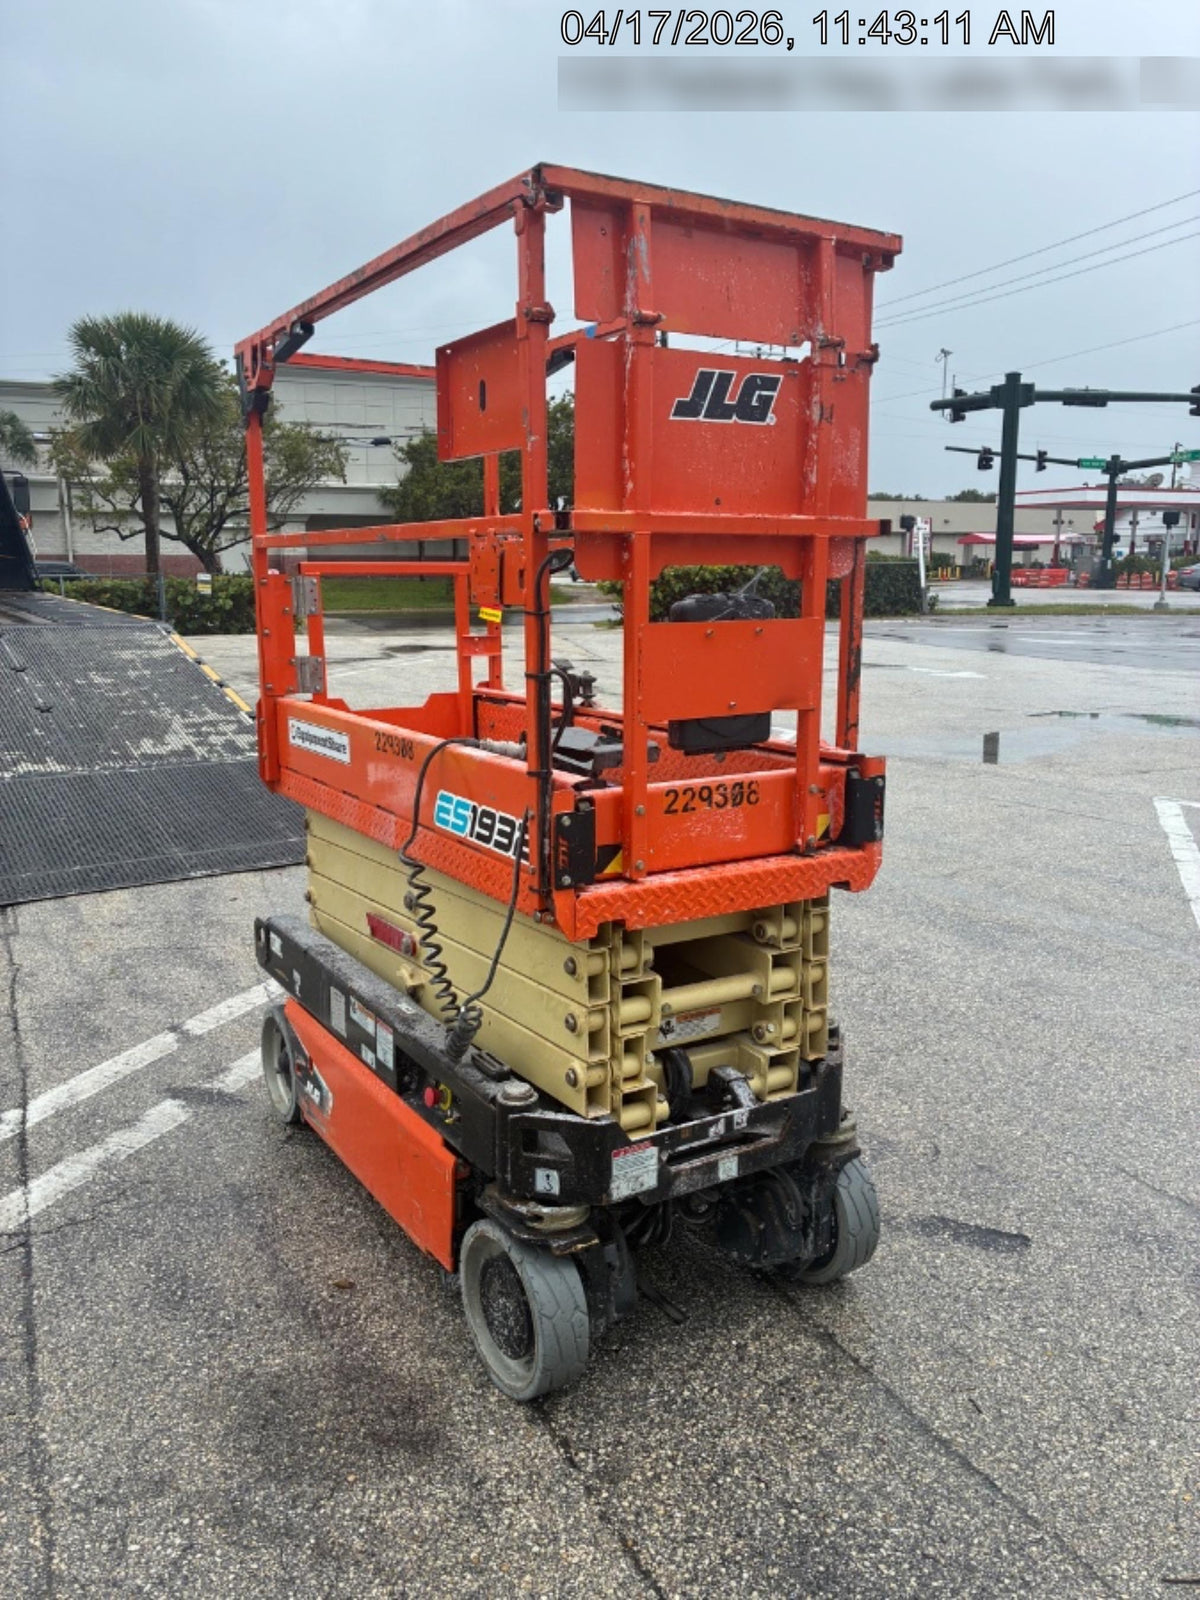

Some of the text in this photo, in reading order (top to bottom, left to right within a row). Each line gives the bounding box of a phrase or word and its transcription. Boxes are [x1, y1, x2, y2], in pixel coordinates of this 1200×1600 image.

[669, 368, 784, 424] JLG
[375, 731, 415, 760] 229308
[663, 780, 760, 815] 229308
